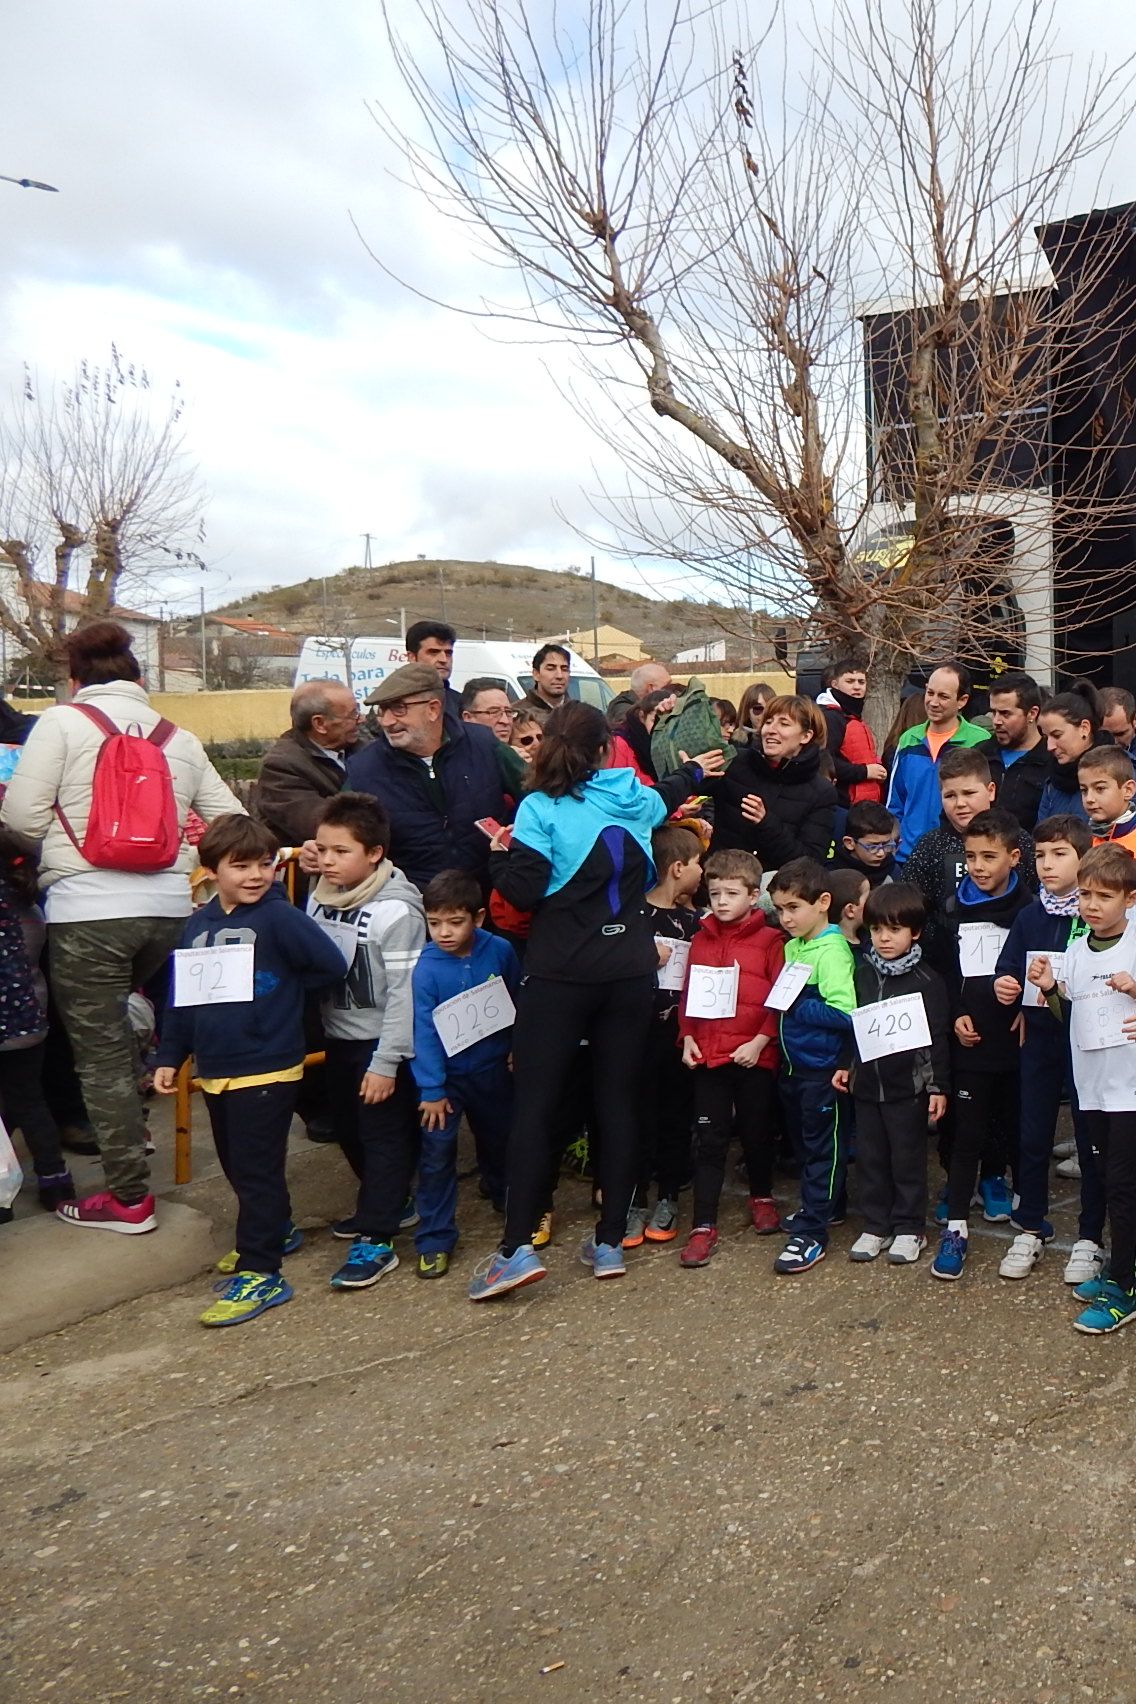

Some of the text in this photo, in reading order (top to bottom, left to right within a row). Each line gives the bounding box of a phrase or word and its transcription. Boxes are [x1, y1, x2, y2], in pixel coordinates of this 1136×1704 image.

[189, 961, 228, 991] 92
[702, 975, 733, 1007] 34
[448, 994, 499, 1040] 226
[867, 1012, 912, 1037] 420
